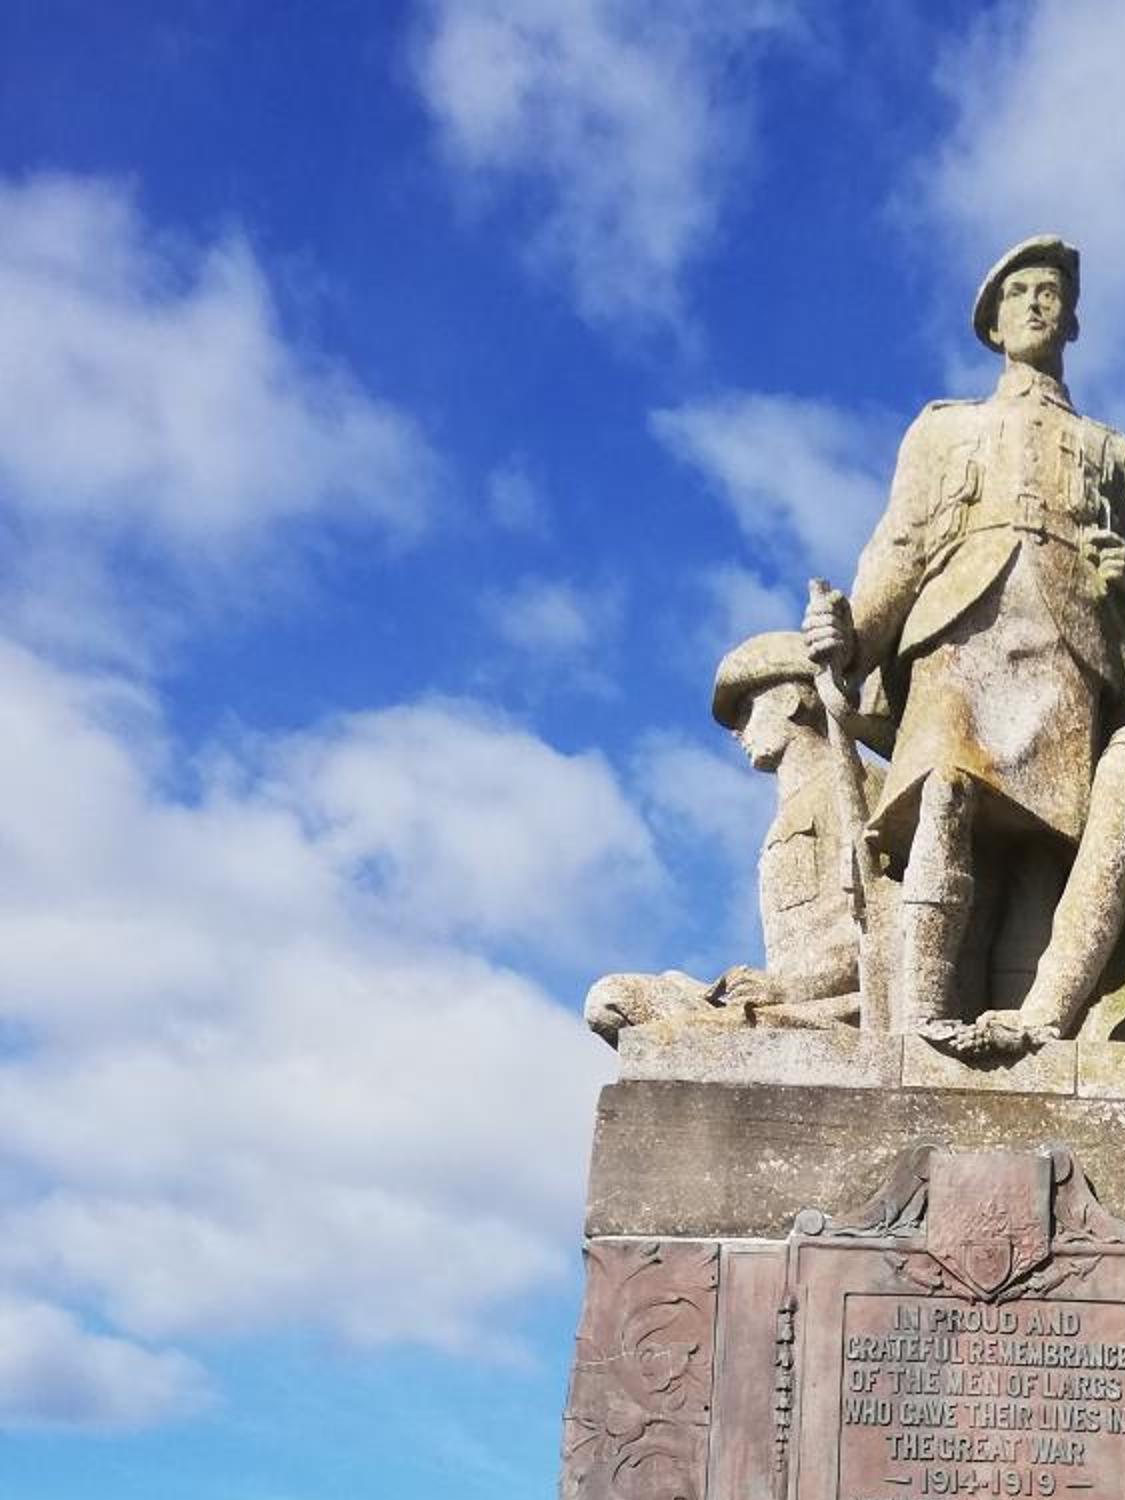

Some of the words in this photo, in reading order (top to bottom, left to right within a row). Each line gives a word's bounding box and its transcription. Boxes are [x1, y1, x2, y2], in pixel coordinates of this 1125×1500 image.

[894, 1304, 921, 1330] IN
[931, 1307, 1018, 1334] PROUD
[1026, 1310, 1081, 1337] AND
[848, 1334, 964, 1364] GRATEFUL
[851, 1368, 881, 1393] OF
[886, 1369, 941, 1395] THE
[947, 1371, 1000, 1397] MEN
[1007, 1374, 1039, 1399] OF
[1042, 1374, 1122, 1401] LARGS
[845, 1399, 893, 1426] WHO
[900, 1400, 958, 1428] GAVE
[963, 1403, 1034, 1431] THEIR
[1038, 1406, 1100, 1433] LIVES
[886, 1433, 935, 1461] THE
[938, 1435, 1022, 1463] GREAT
[1028, 1438, 1085, 1466] WAR
